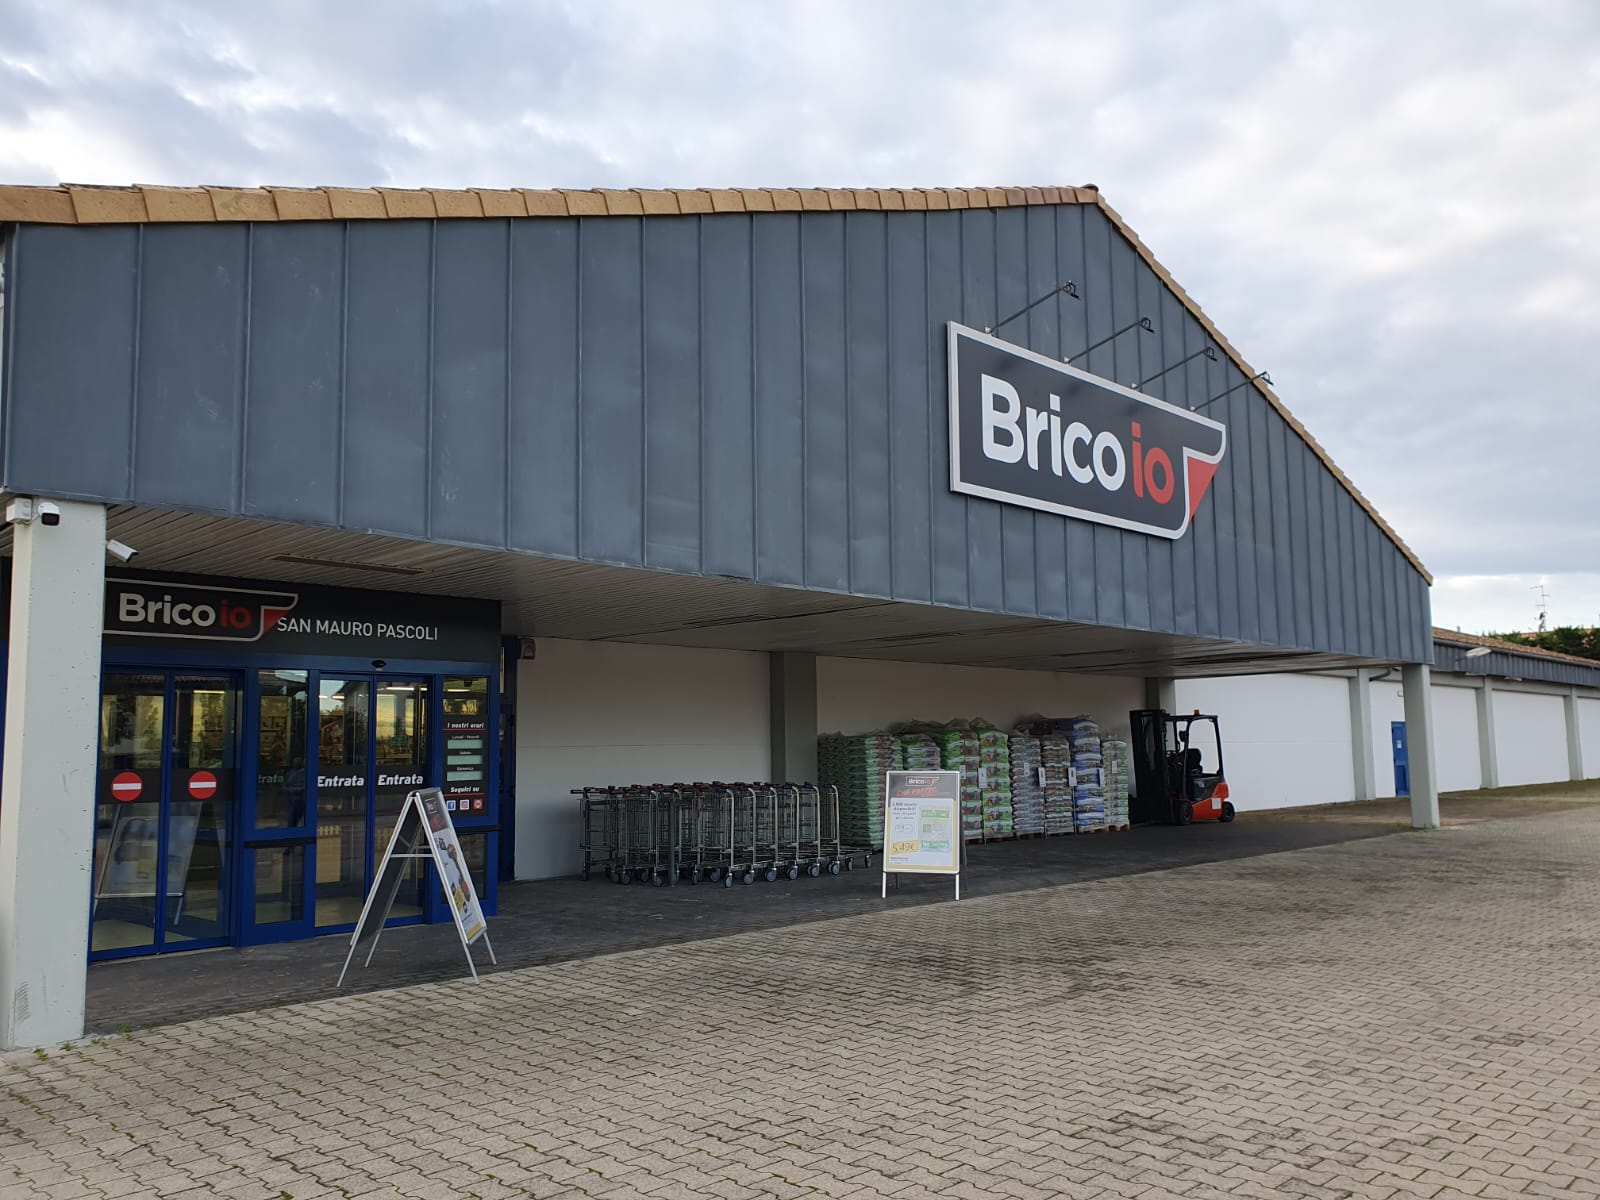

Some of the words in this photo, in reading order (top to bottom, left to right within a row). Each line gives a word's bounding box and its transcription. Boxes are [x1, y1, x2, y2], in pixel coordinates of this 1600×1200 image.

[277, 616, 311, 633] SAN
[316, 619, 373, 637] MAURO
[377, 623, 438, 641] PASCOLI
[317, 775, 365, 788] Entrata
[377, 773, 424, 786] Entrata
